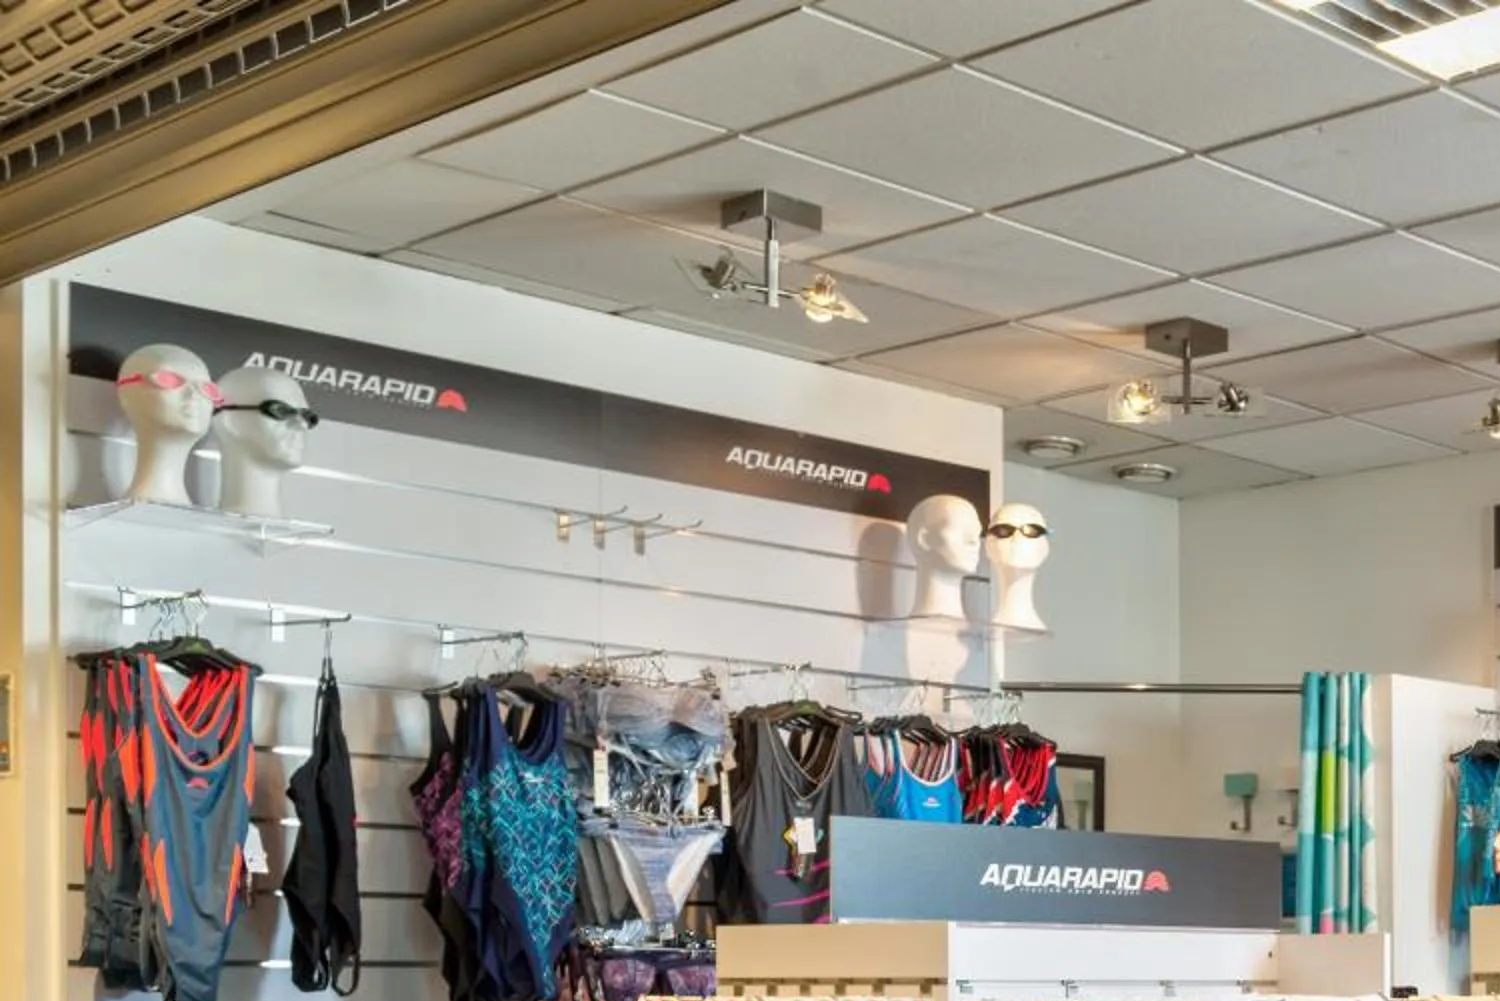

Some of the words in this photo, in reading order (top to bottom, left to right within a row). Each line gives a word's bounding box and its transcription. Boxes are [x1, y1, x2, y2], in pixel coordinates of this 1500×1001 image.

[243, 352, 436, 404] AQUARAPID
[726, 447, 868, 488] AQUARAPID
[980, 864, 1143, 892] AQUARAPID
